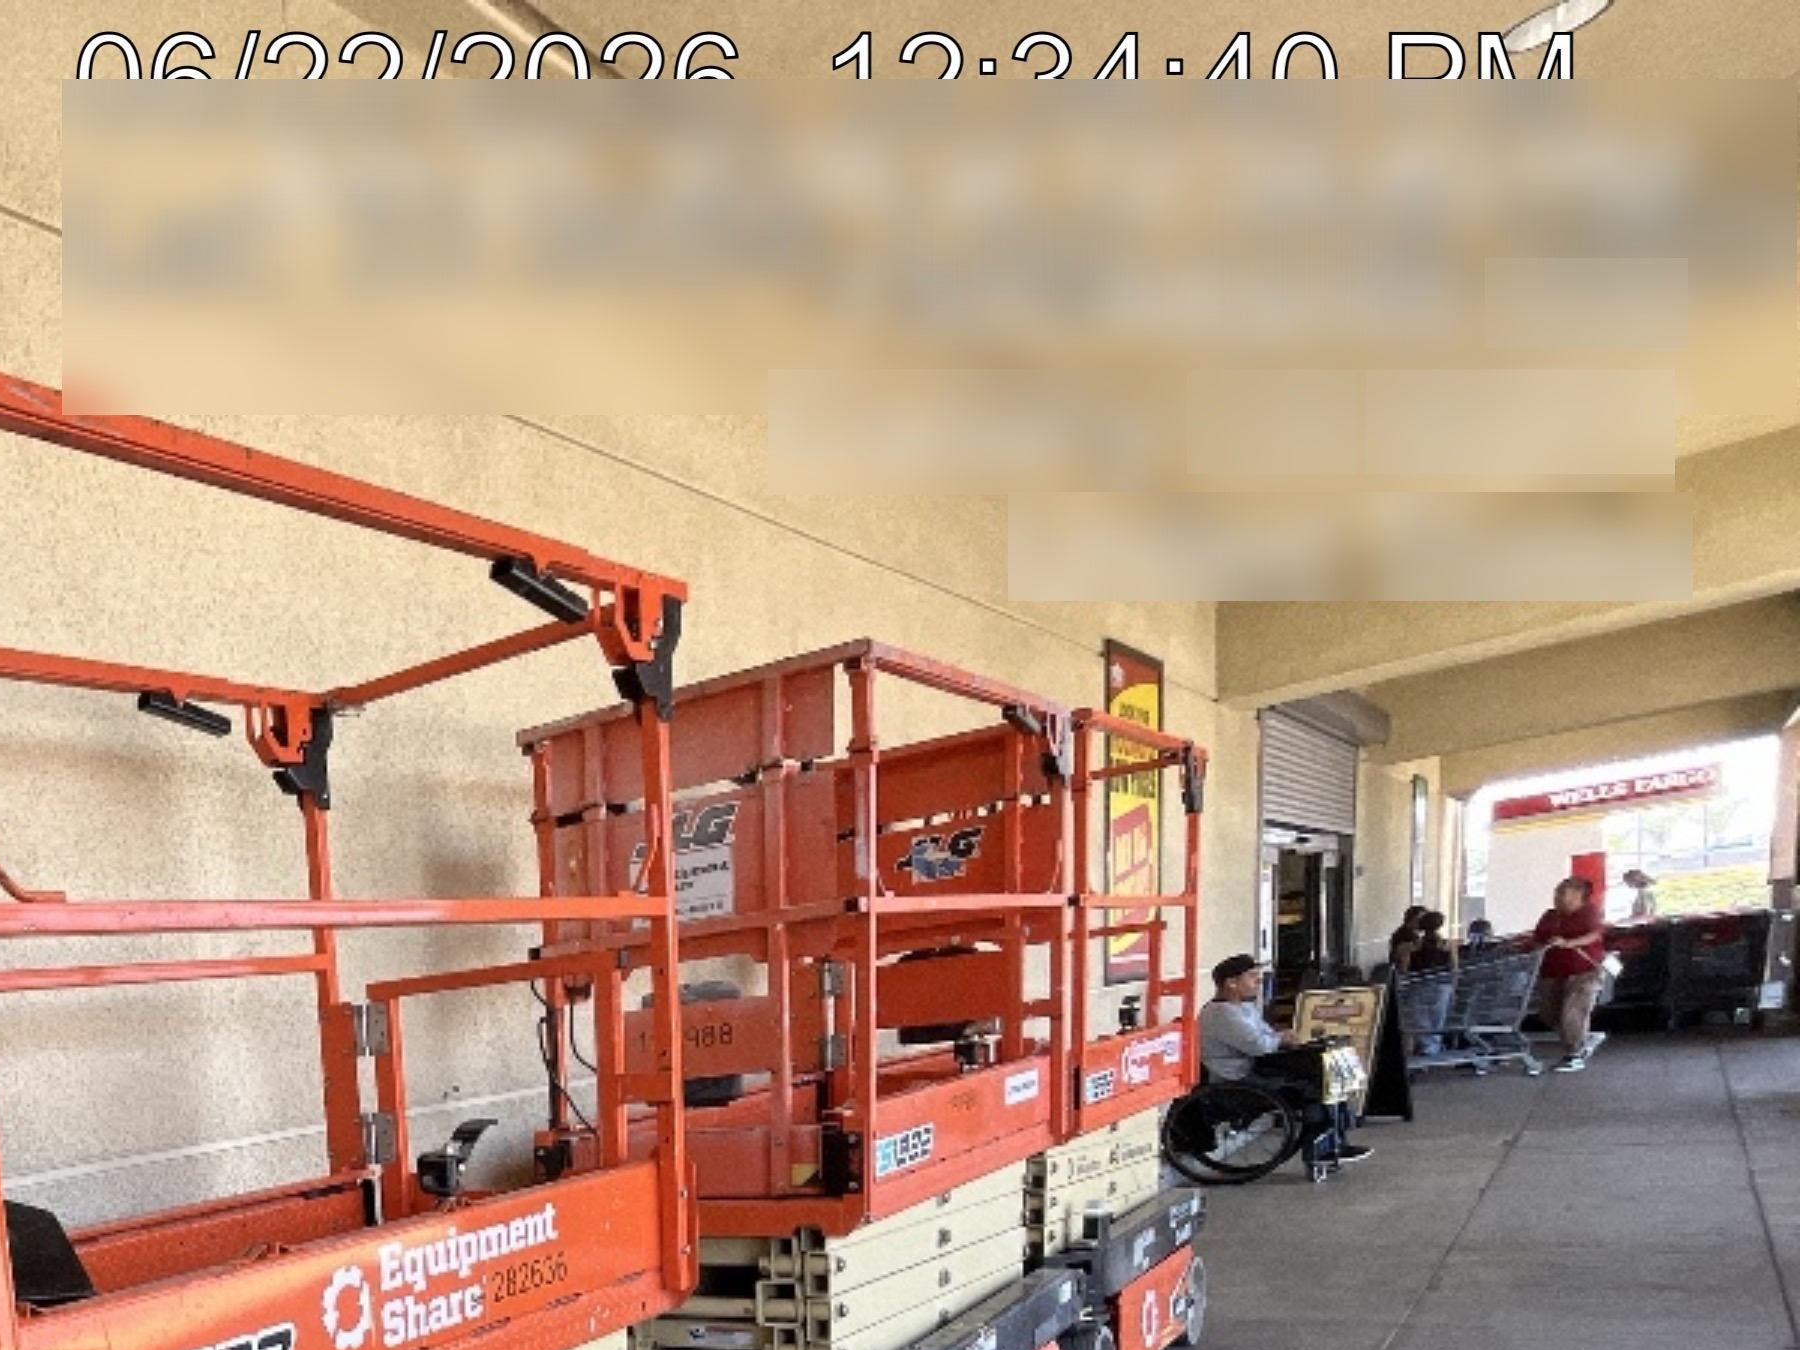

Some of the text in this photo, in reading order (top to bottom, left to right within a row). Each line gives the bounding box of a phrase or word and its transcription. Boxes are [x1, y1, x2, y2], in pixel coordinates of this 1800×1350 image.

[378, 1202, 559, 1293] Equipment
[491, 1251, 568, 1303] 282636
[382, 1283, 486, 1348] Share
